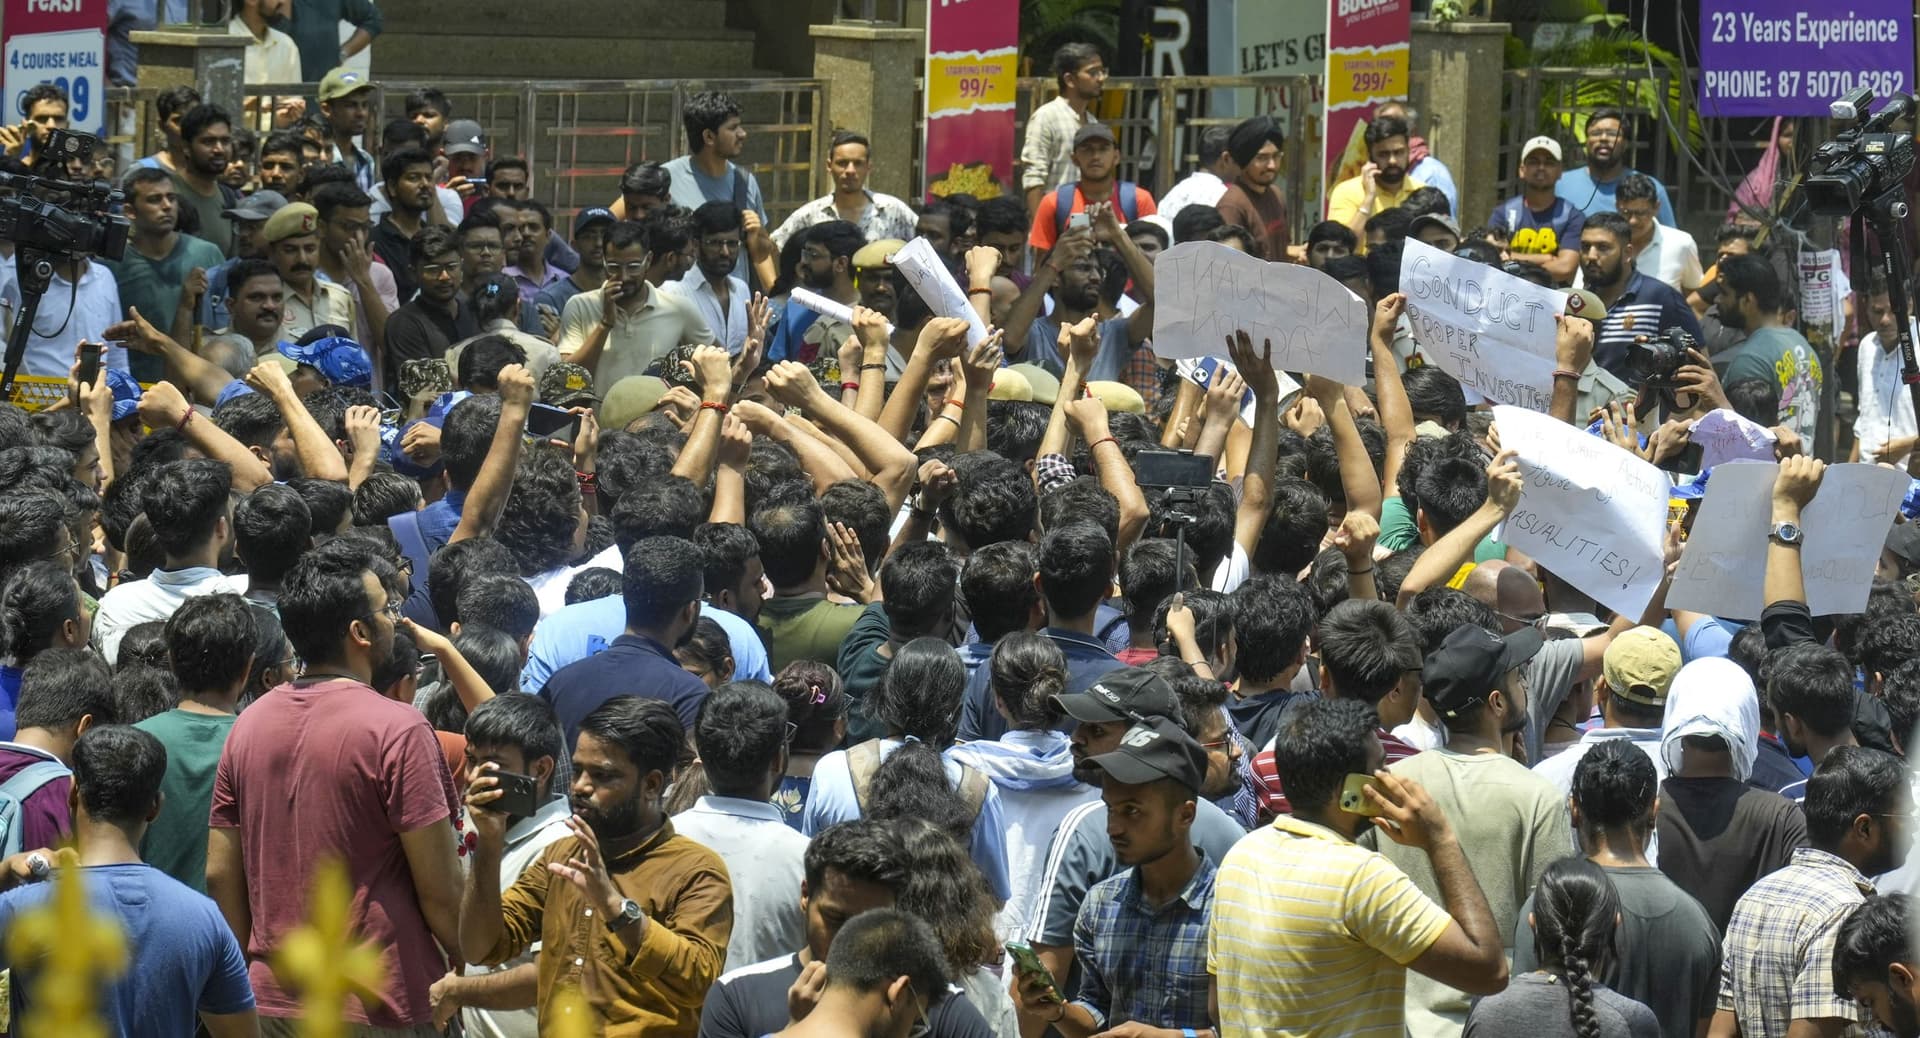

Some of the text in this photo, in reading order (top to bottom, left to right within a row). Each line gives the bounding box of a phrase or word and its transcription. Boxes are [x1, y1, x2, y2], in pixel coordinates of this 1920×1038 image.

[1711, 11, 1899, 49] 23 Years Experience
[10, 49, 99, 70] 4 COURSE MEAL
[1240, 39, 1298, 74] LET'S
[959, 77, 995, 99] 99/-
[1352, 72, 1393, 93] 299/-
[1705, 70, 1772, 98] PHONE:
[1777, 71, 1801, 98] 87
[1806, 71, 1852, 98] 5070
[1803, 270, 1830, 283] PG
[1511, 494, 1641, 591] ASUALITIES!
